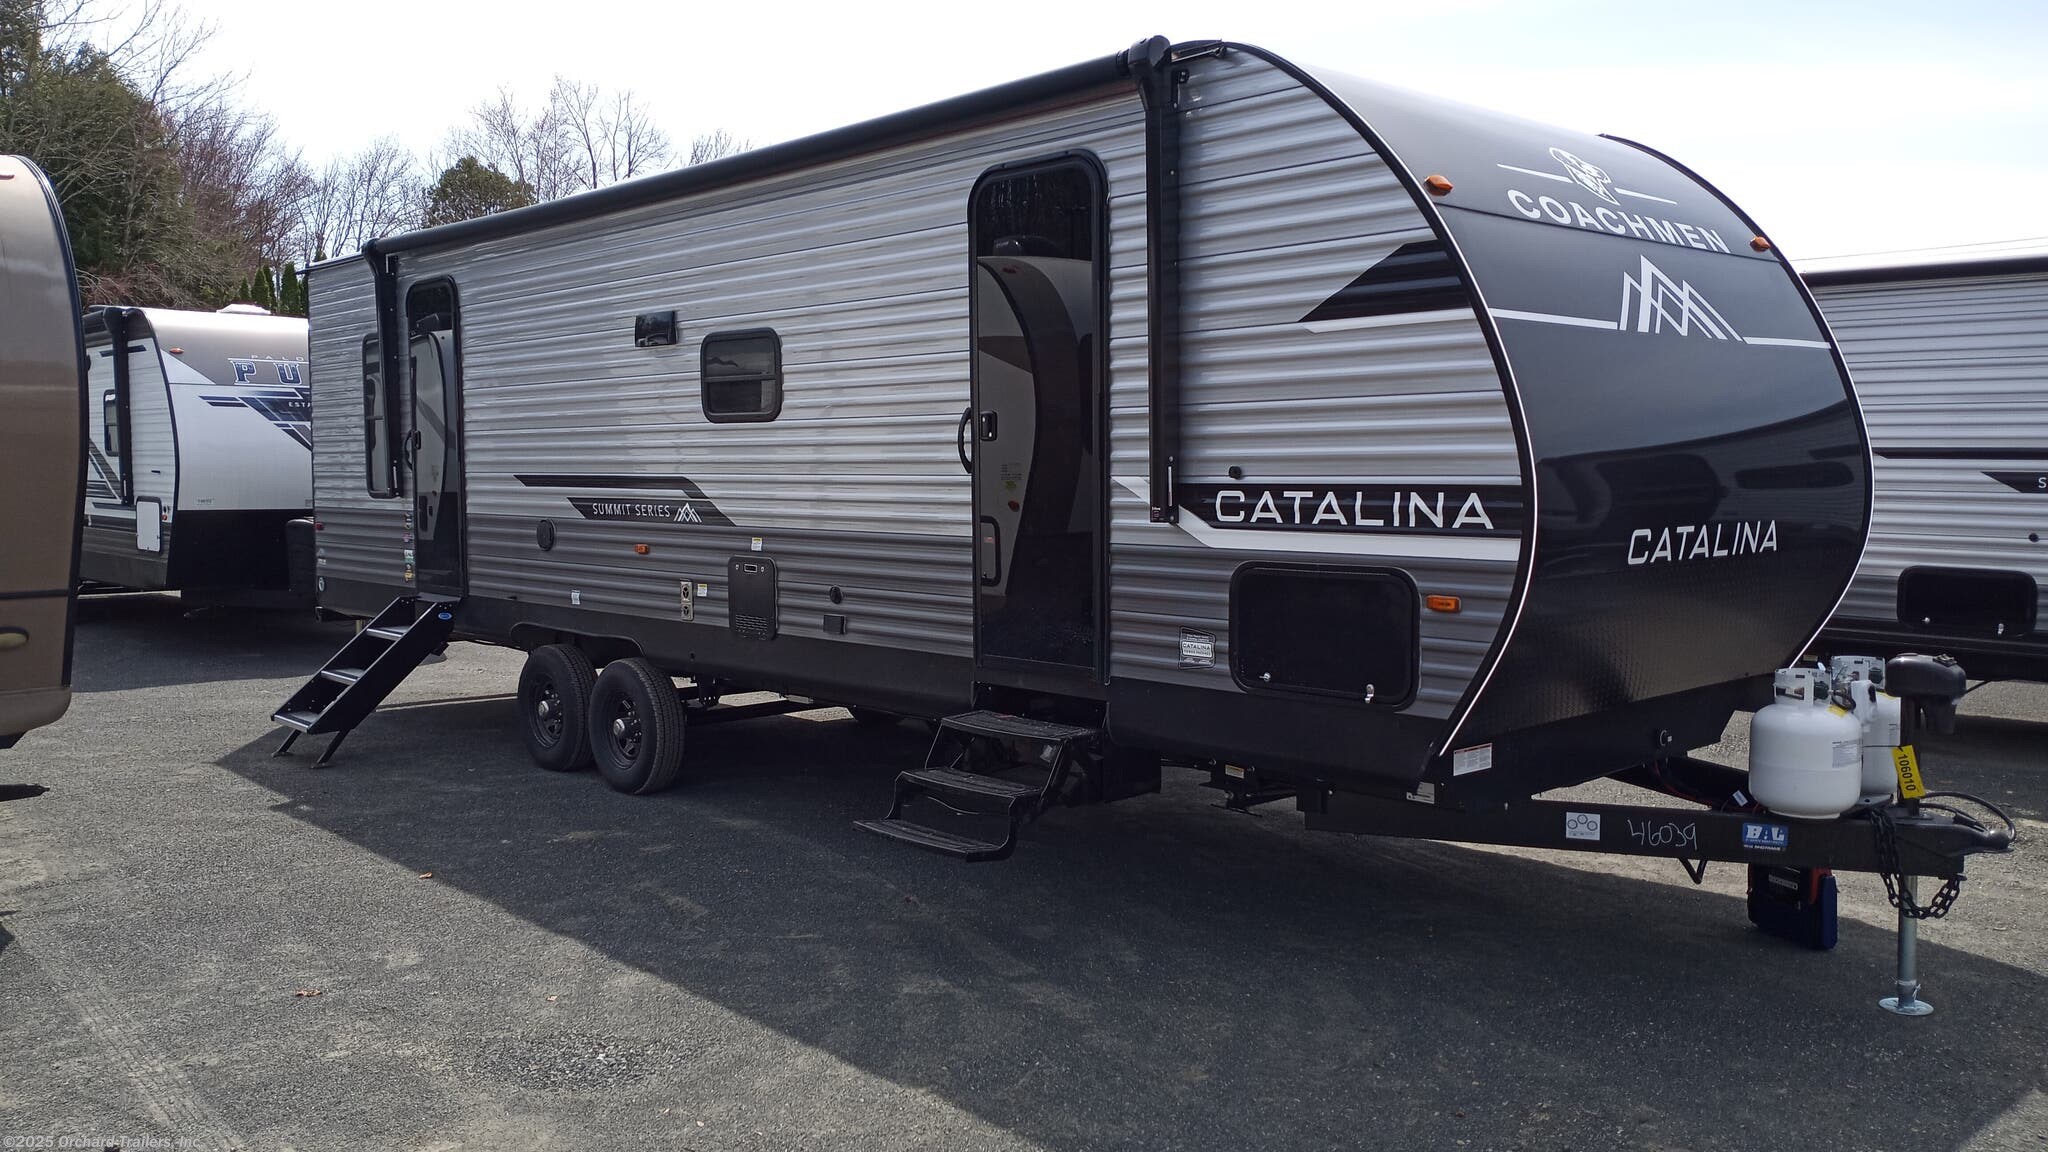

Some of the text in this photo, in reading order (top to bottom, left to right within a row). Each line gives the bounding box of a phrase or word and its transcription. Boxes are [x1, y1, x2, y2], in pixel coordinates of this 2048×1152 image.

[1507, 189, 1731, 254] COACHMEN
[230, 360, 303, 385] PU
[592, 502, 671, 518] SUMMIT SERIES
[1215, 490, 1495, 530] CATALINA
[1627, 519, 1778, 565] CATALINA
[1182, 642, 1211, 650] CATALINA
[1897, 753, 1917, 791] 106010
[1627, 819, 1698, 851] 46039
